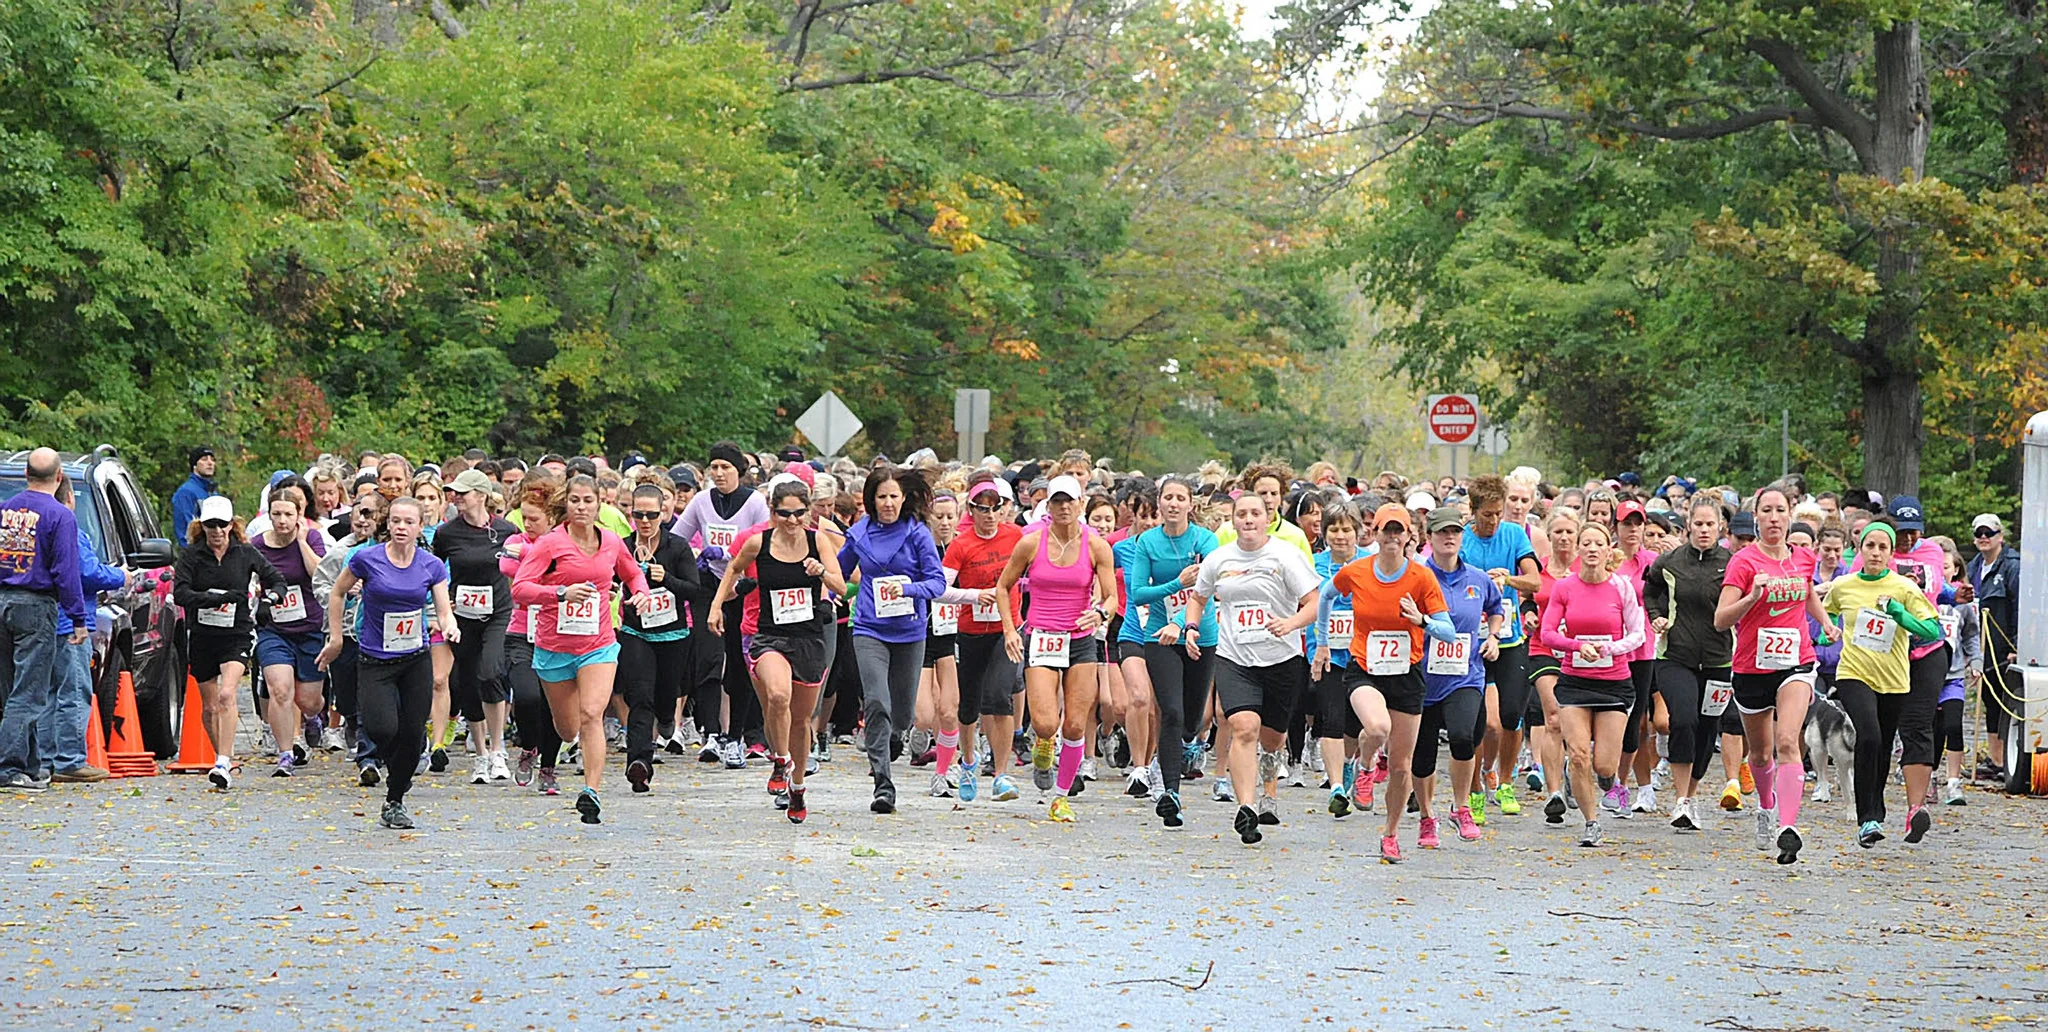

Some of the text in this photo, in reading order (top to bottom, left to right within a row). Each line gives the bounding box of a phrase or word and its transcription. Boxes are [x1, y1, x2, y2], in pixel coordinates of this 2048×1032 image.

[1436, 404, 1470, 413] DO NOT
[1439, 425, 1468, 435] ENTER
[710, 531, 732, 546] 260
[463, 594, 486, 607] 274
[778, 589, 805, 607] 750
[566, 601, 592, 617] 629
[939, 605, 960, 620] 438
[1238, 609, 1264, 626] 479
[396, 620, 413, 635] 47
[1329, 619, 1352, 634] 307
[1866, 618, 1884, 635] 45
[1037, 637, 1063, 652] 163
[1380, 640, 1398, 657] 72
[1437, 641, 1463, 658] 808
[1764, 636, 1792, 654] 222
